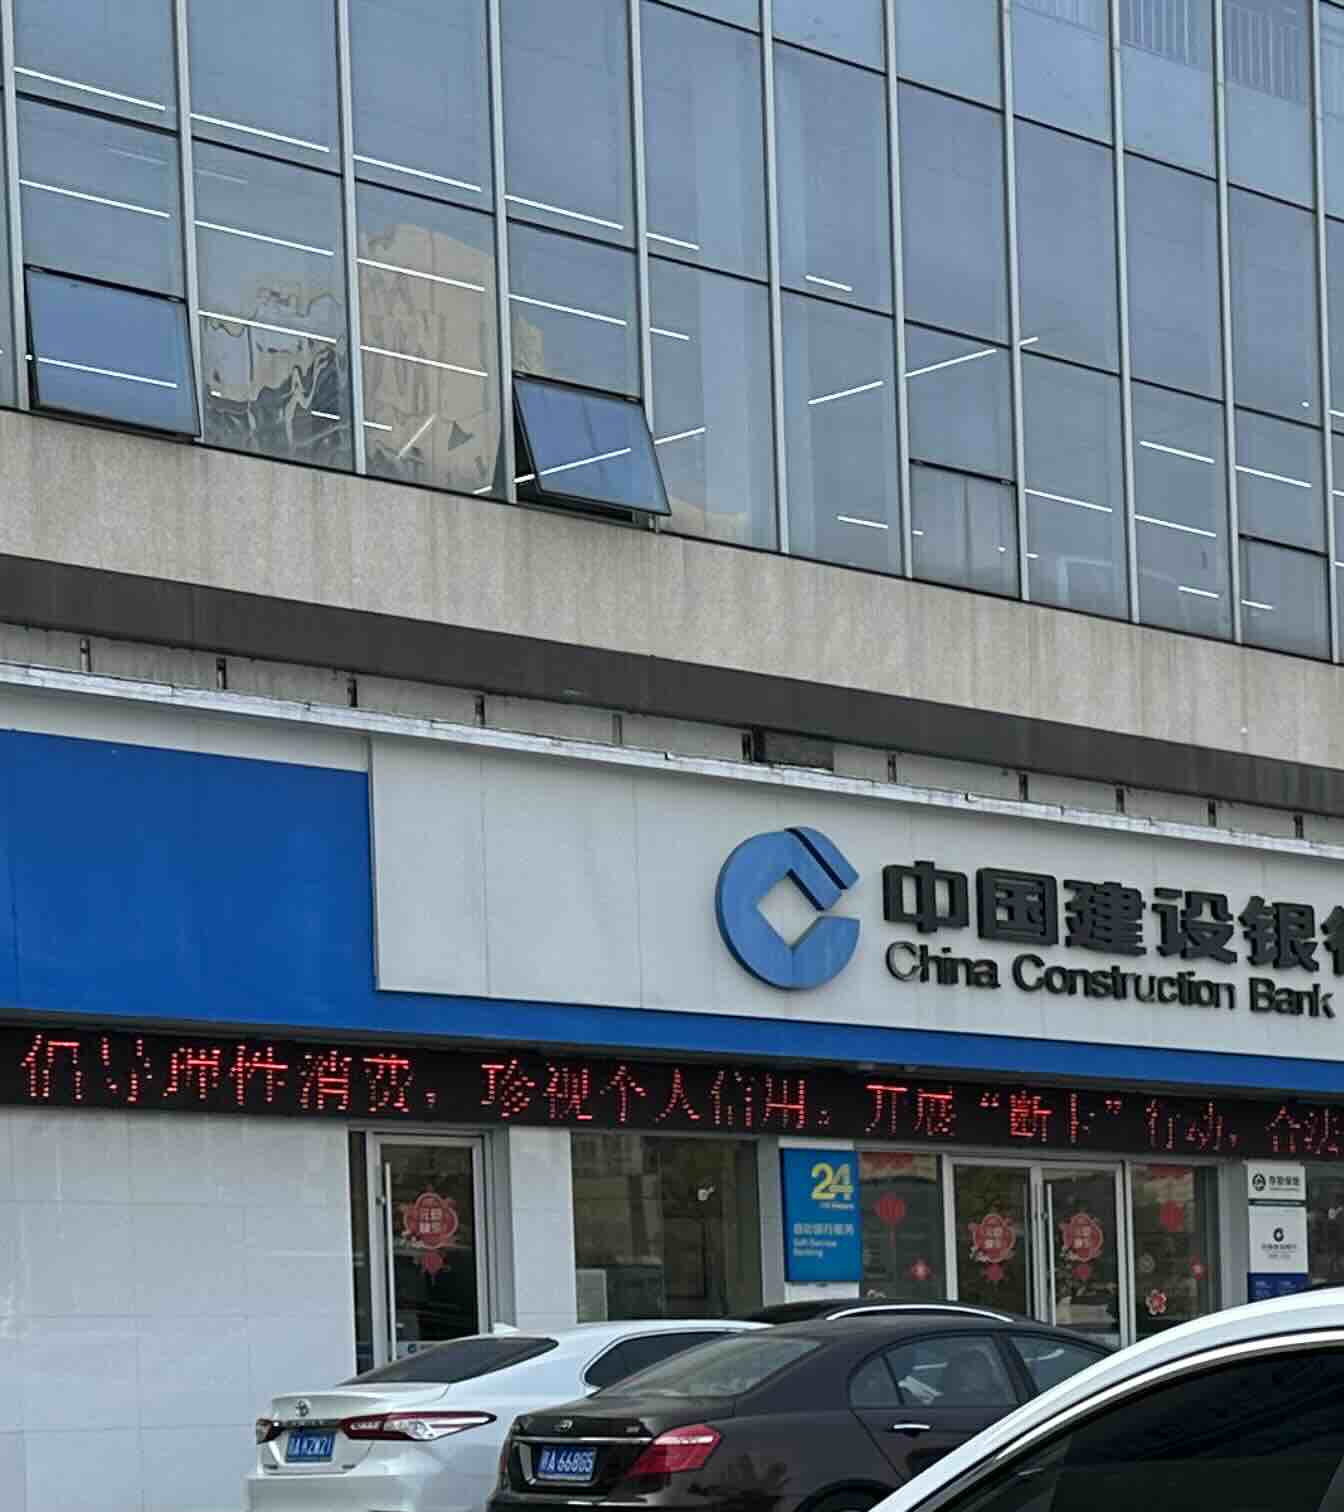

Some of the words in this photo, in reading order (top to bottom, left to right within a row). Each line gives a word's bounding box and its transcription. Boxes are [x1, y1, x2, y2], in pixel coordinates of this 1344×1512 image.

[884, 940, 1001, 990] China
[1011, 953, 1237, 1012] Construction
[1248, 978, 1336, 1020] Bank
[810, 1161, 855, 1201] 24
